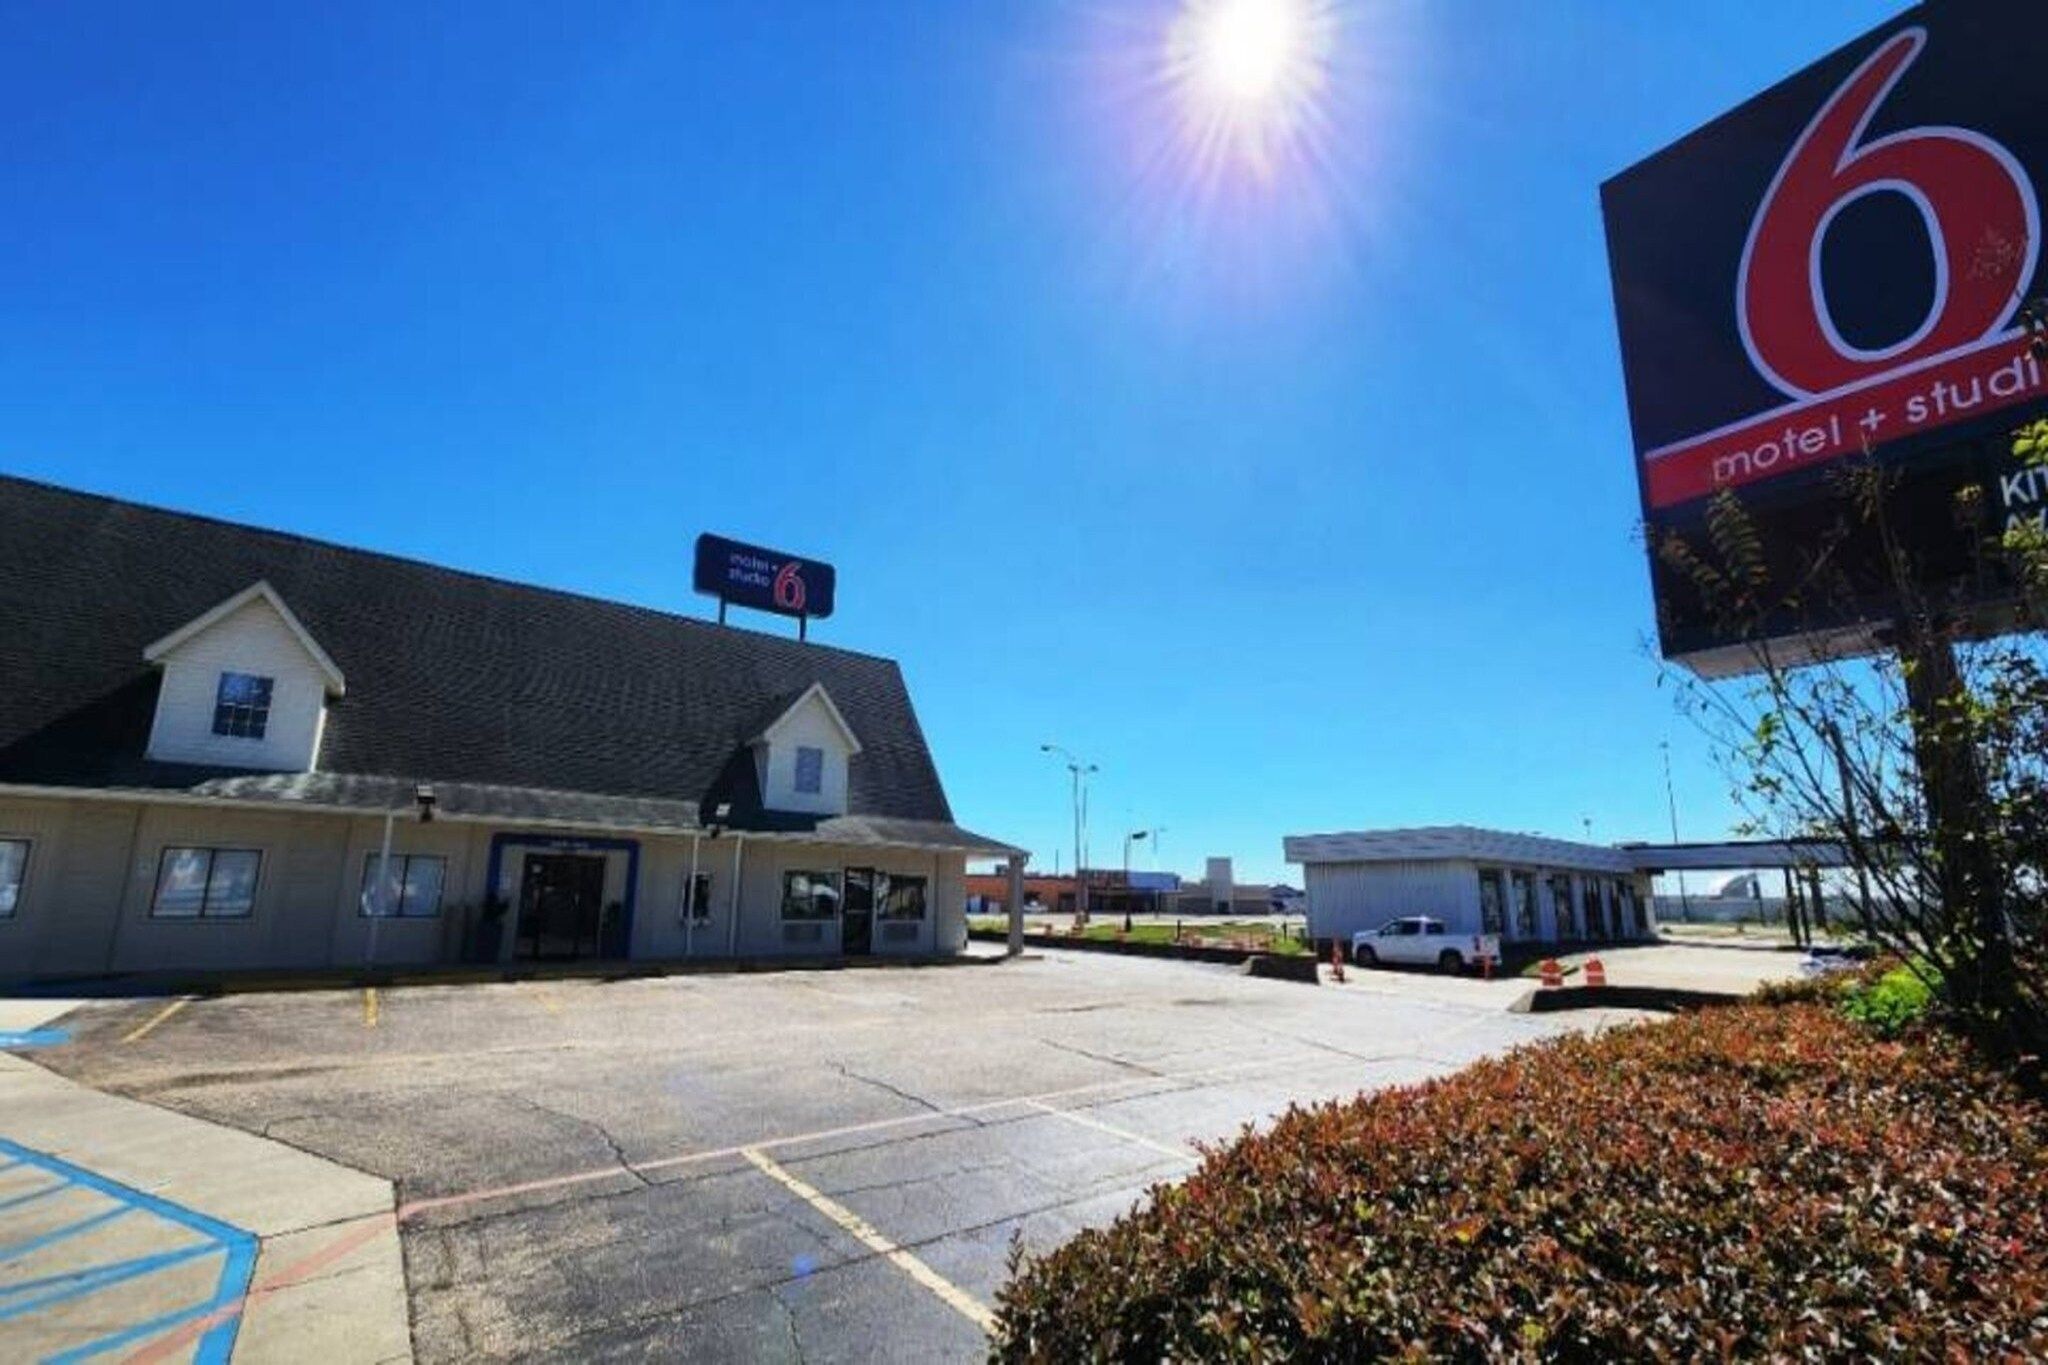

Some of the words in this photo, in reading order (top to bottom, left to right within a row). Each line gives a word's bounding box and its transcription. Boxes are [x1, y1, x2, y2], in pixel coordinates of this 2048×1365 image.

[1736, 26, 2041, 401] 6
[1712, 414, 1842, 483] motel
[1906, 353, 2041, 423] studi
[774, 562, 806, 610] 6
